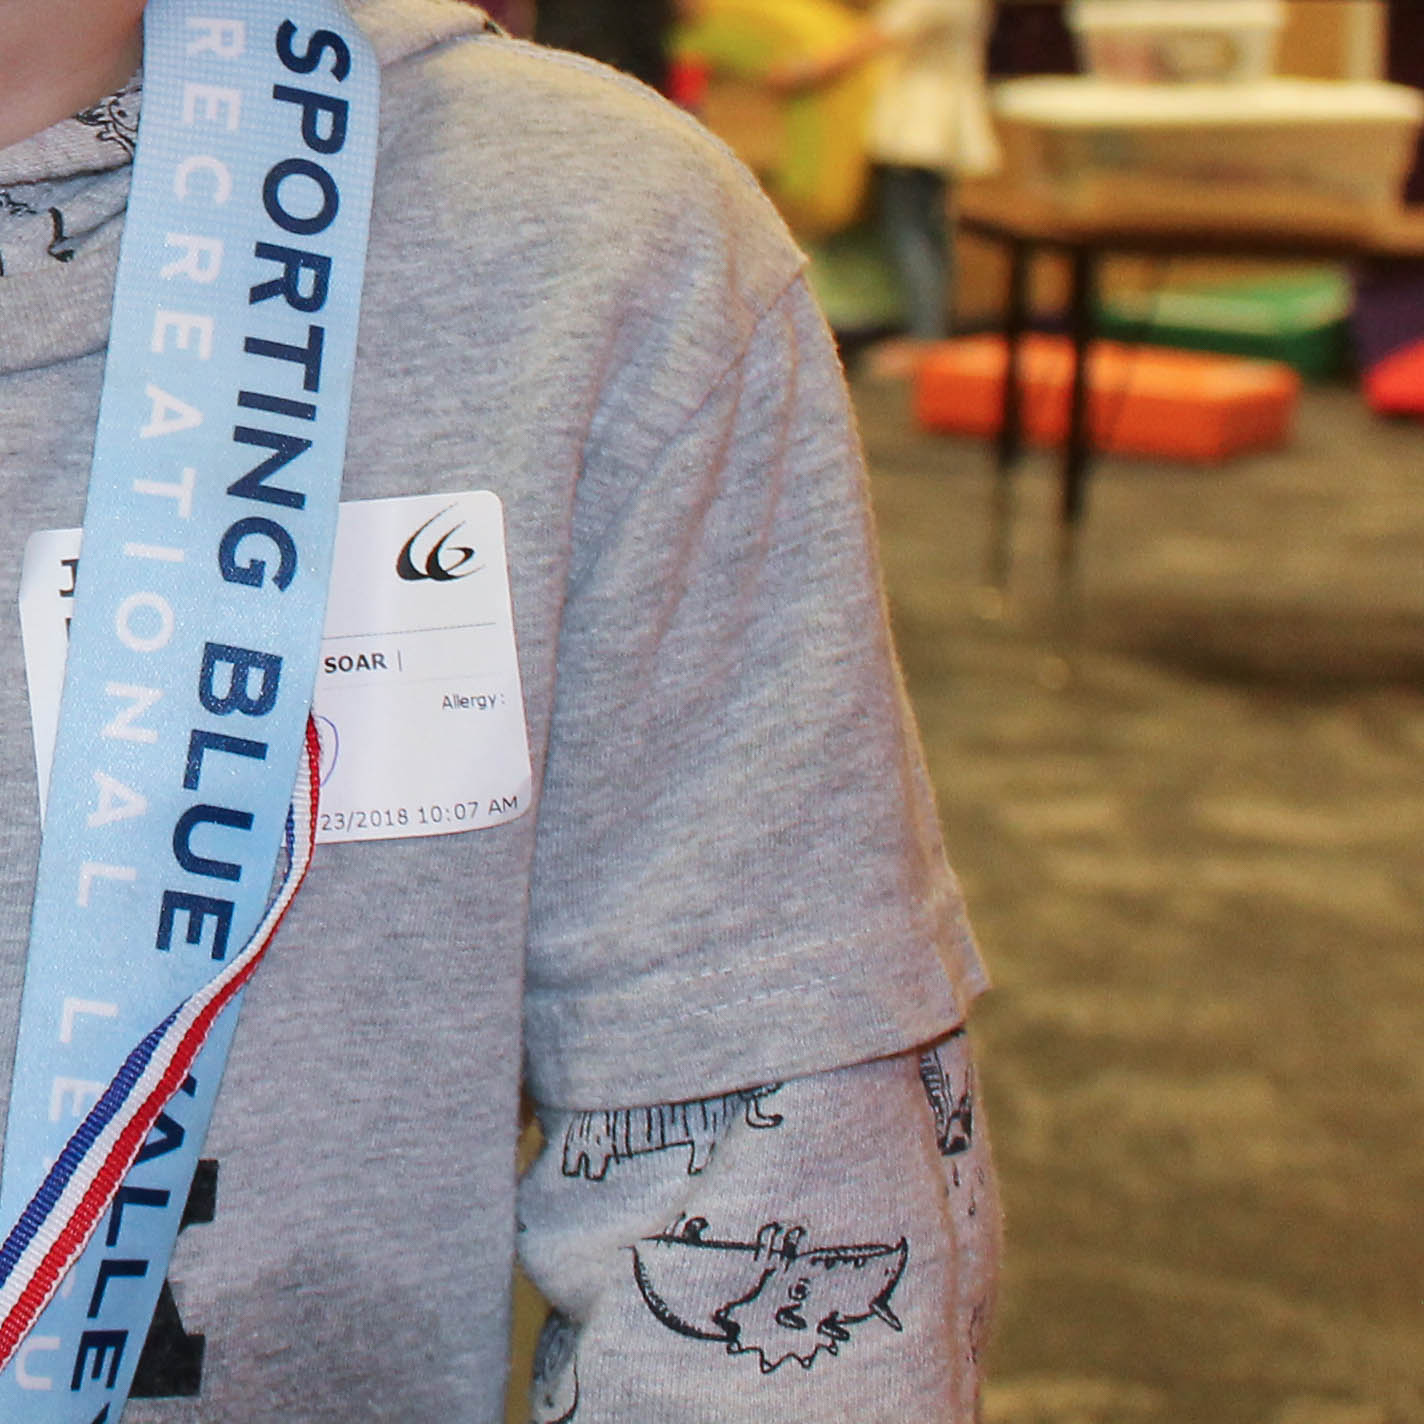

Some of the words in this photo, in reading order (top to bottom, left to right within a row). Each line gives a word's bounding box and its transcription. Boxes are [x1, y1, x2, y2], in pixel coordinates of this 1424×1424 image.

[78, 16, 248, 908] RECREATIONAL
[217, 19, 352, 593] SPORTING
[156, 642, 284, 962] BLUE
[324, 653, 387, 674] SOAR
[418, 801, 479, 825] 10:07
[487, 795, 518, 815] AM
